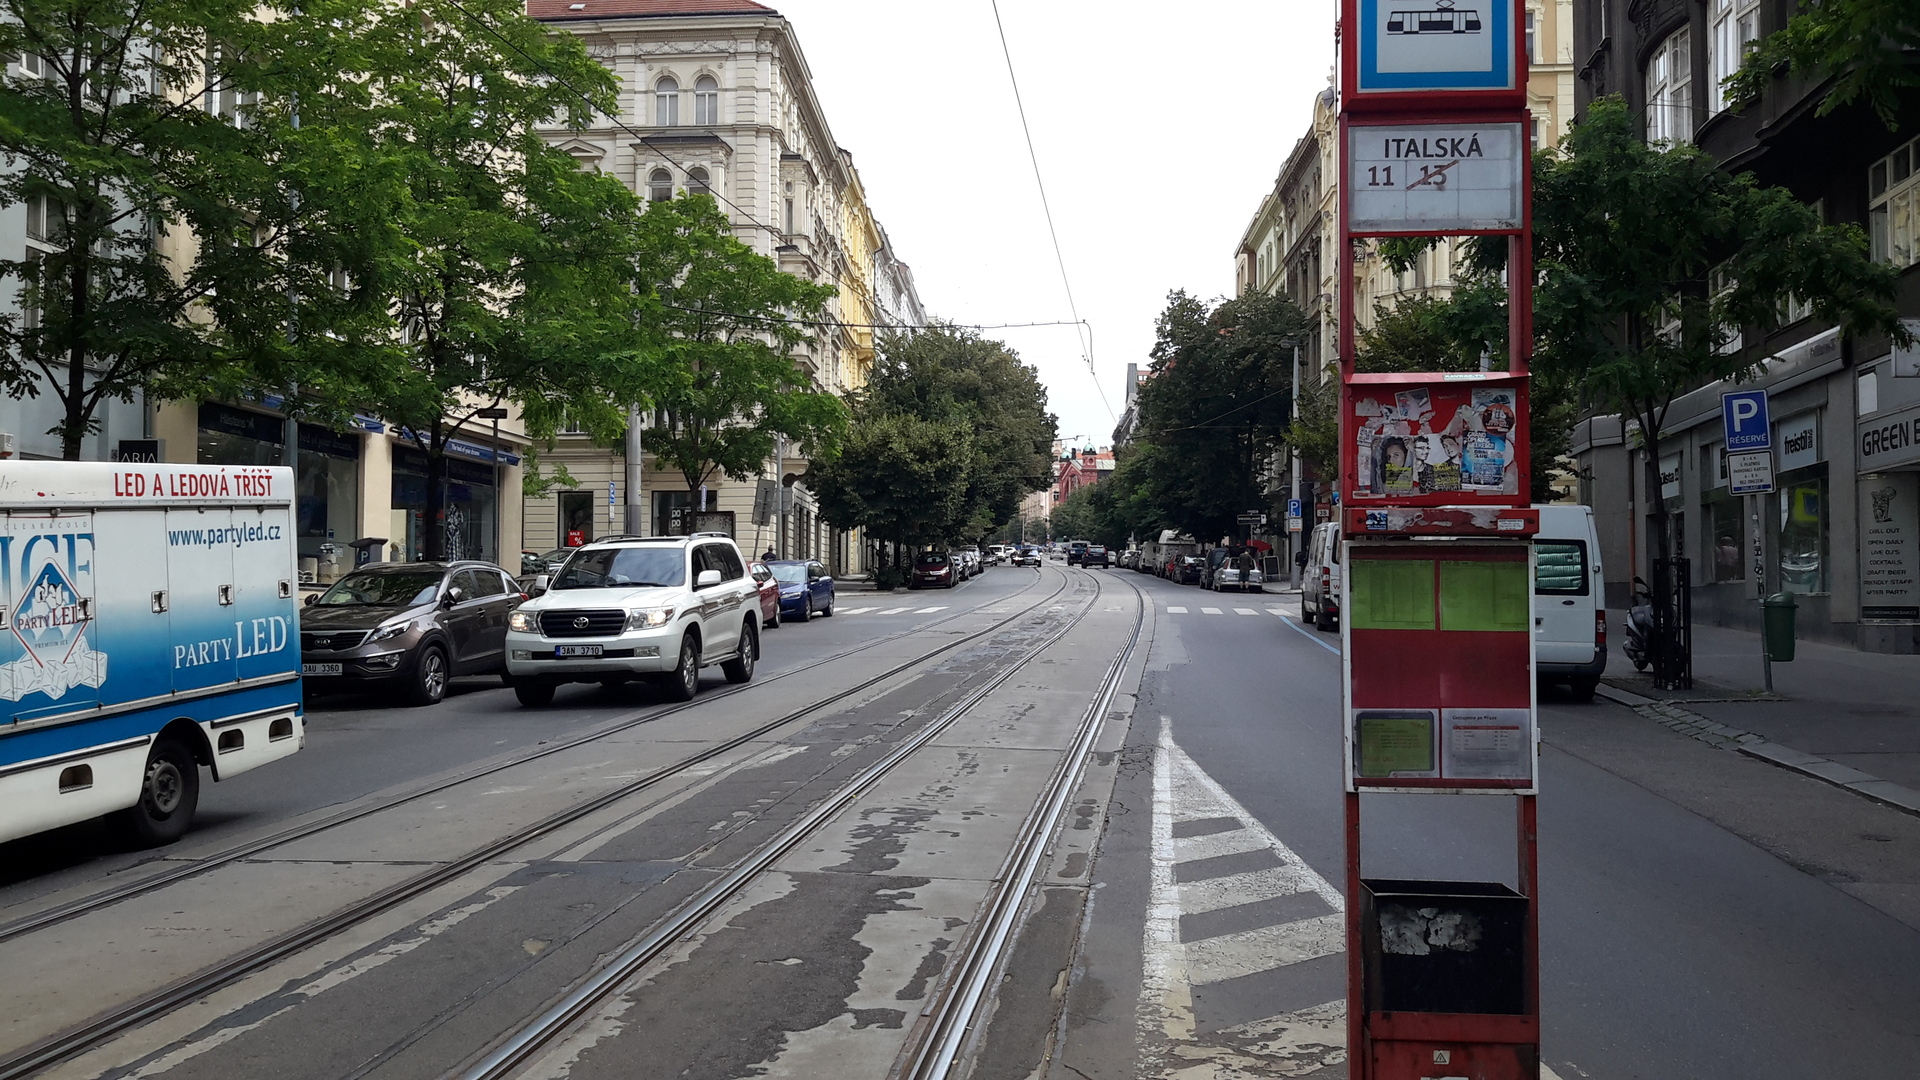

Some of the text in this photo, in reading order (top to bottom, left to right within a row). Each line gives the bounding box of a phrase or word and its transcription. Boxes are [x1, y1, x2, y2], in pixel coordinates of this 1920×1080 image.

[1384, 133, 1483, 158] ITALSKÁ
[1368, 165, 1395, 186] 11
[1732, 398, 1758, 432] P
[1729, 433, 1767, 445] RÉSERVÉ
[1862, 421, 1909, 456] GREEN
[121, 452, 156, 462] ARIA
[115, 468, 273, 497] LED A LEDOVÁ TŘÍŠŤ
[168, 521, 281, 550] www.partyled.cz
[361, 551, 369, 561] P
[18, 616, 50, 630] PARTY
[174, 638, 232, 669] PARTY
[562, 646, 600, 655] 3AN 3710
[303, 664, 340, 673] 3AU 3360
